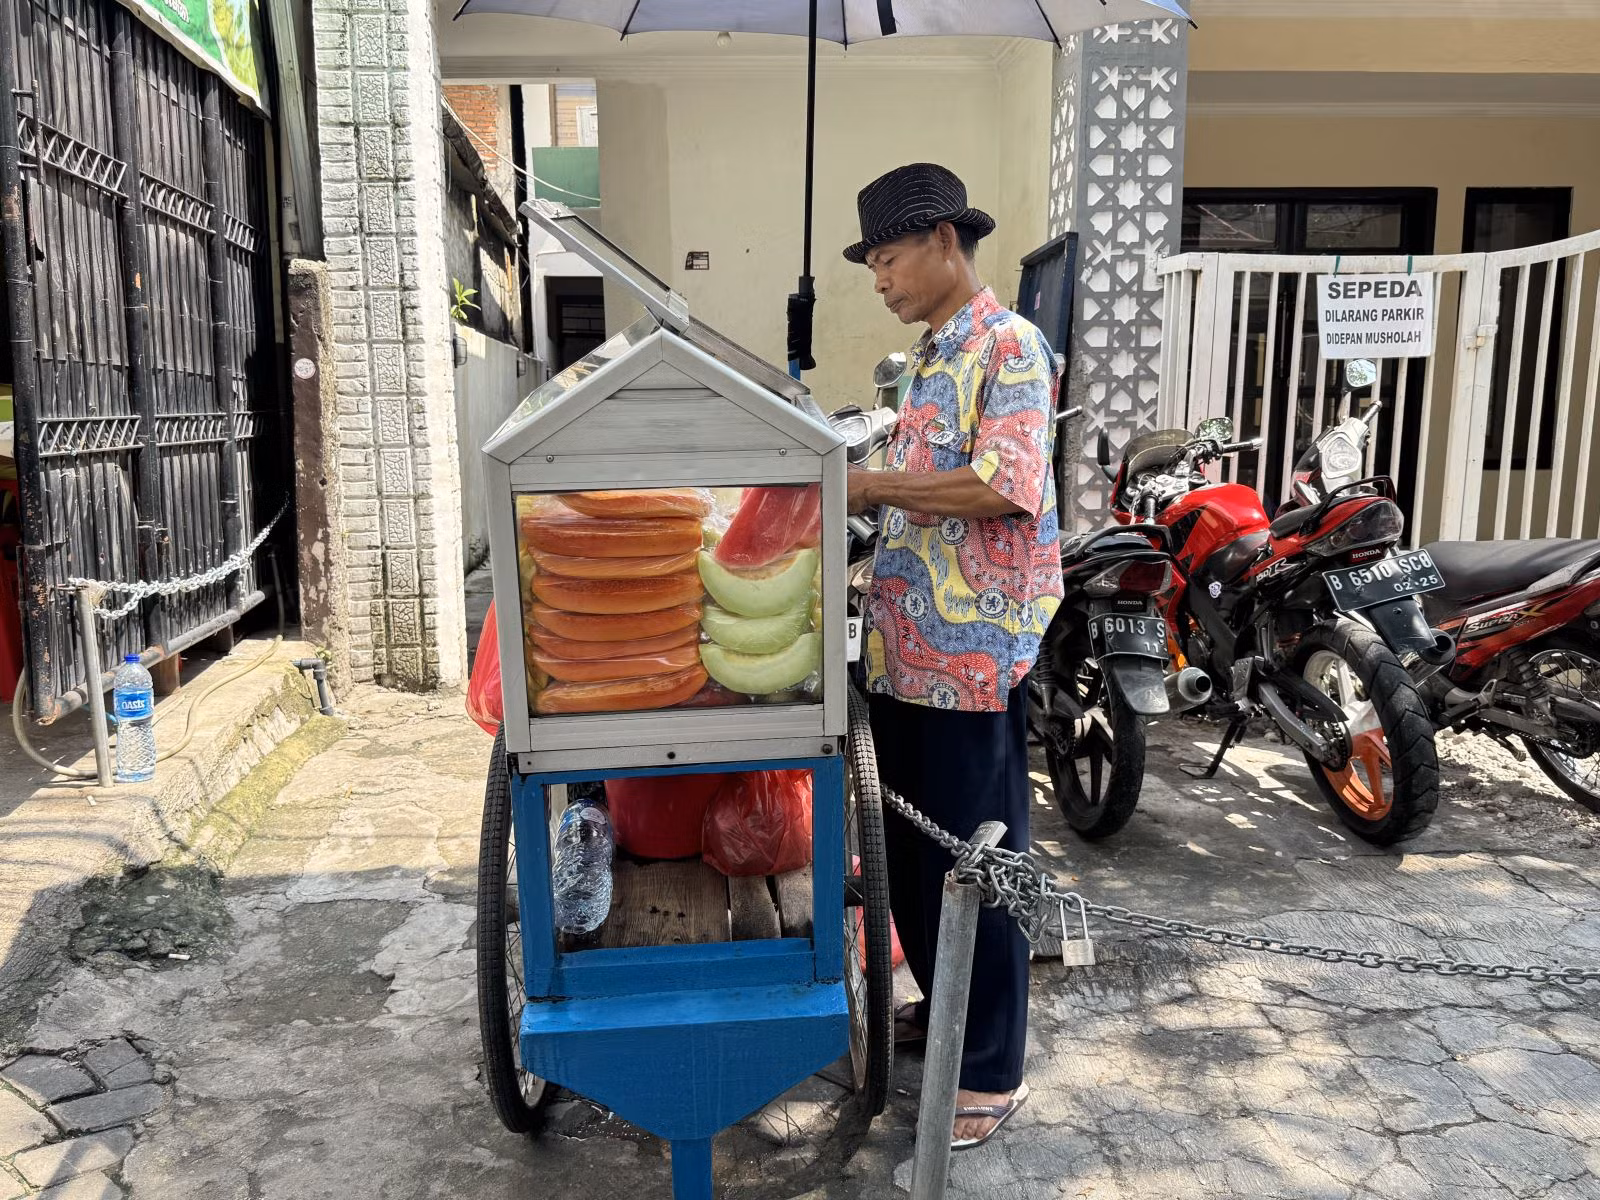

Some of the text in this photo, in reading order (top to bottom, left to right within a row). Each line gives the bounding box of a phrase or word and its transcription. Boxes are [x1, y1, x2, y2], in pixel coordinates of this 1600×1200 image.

[1327, 280, 1423, 299] SEPEDA
[1325, 308, 1424, 322] DILARANG PARKIR
[1326, 331, 1422, 344] DIDEPAN MUSHOLAH
[1352, 549, 1381, 559] HONDA
[1329, 574, 1343, 591] B
[1349, 562, 1393, 586] 6510
[1090, 622, 1098, 640] B
[1104, 617, 1146, 635] 6013
[121, 700, 145, 709] OASIS
